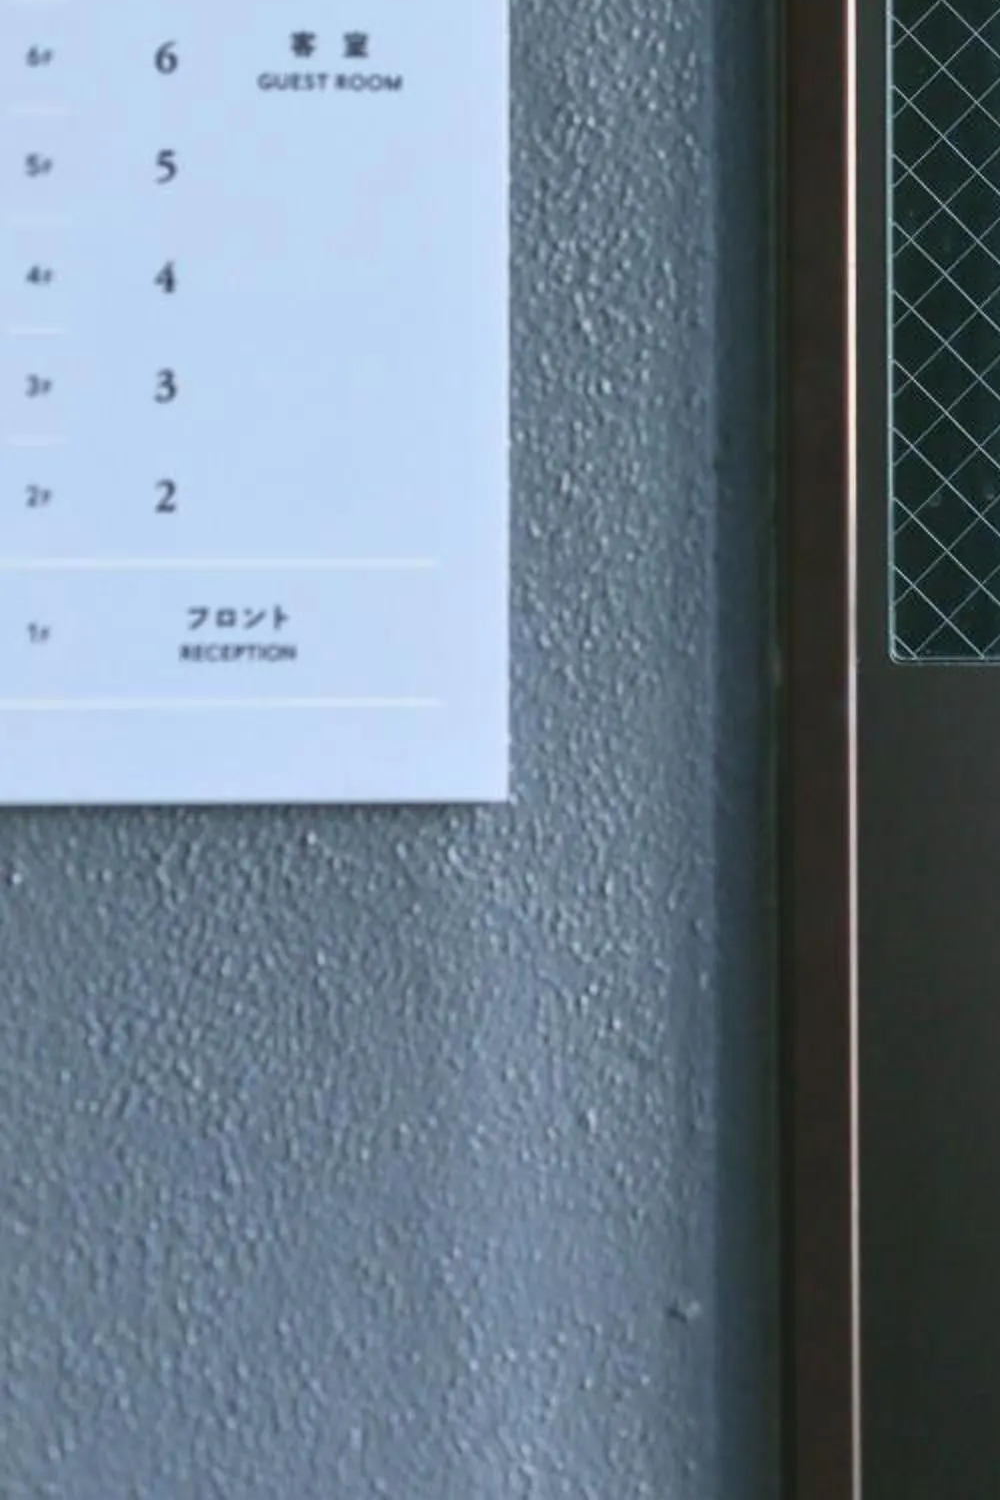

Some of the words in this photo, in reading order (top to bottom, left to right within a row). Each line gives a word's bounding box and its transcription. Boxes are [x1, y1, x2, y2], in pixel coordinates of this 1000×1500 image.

[154, 40, 179, 75] 6
[256, 72, 328, 92] GUEST
[333, 72, 404, 92] ROOM
[155, 149, 178, 185] 5
[153, 261, 178, 295] 4
[154, 368, 178, 404] 3
[154, 479, 177, 514] 2
[187, 604, 290, 631] フロント
[179, 643, 298, 663] RECEPTION
